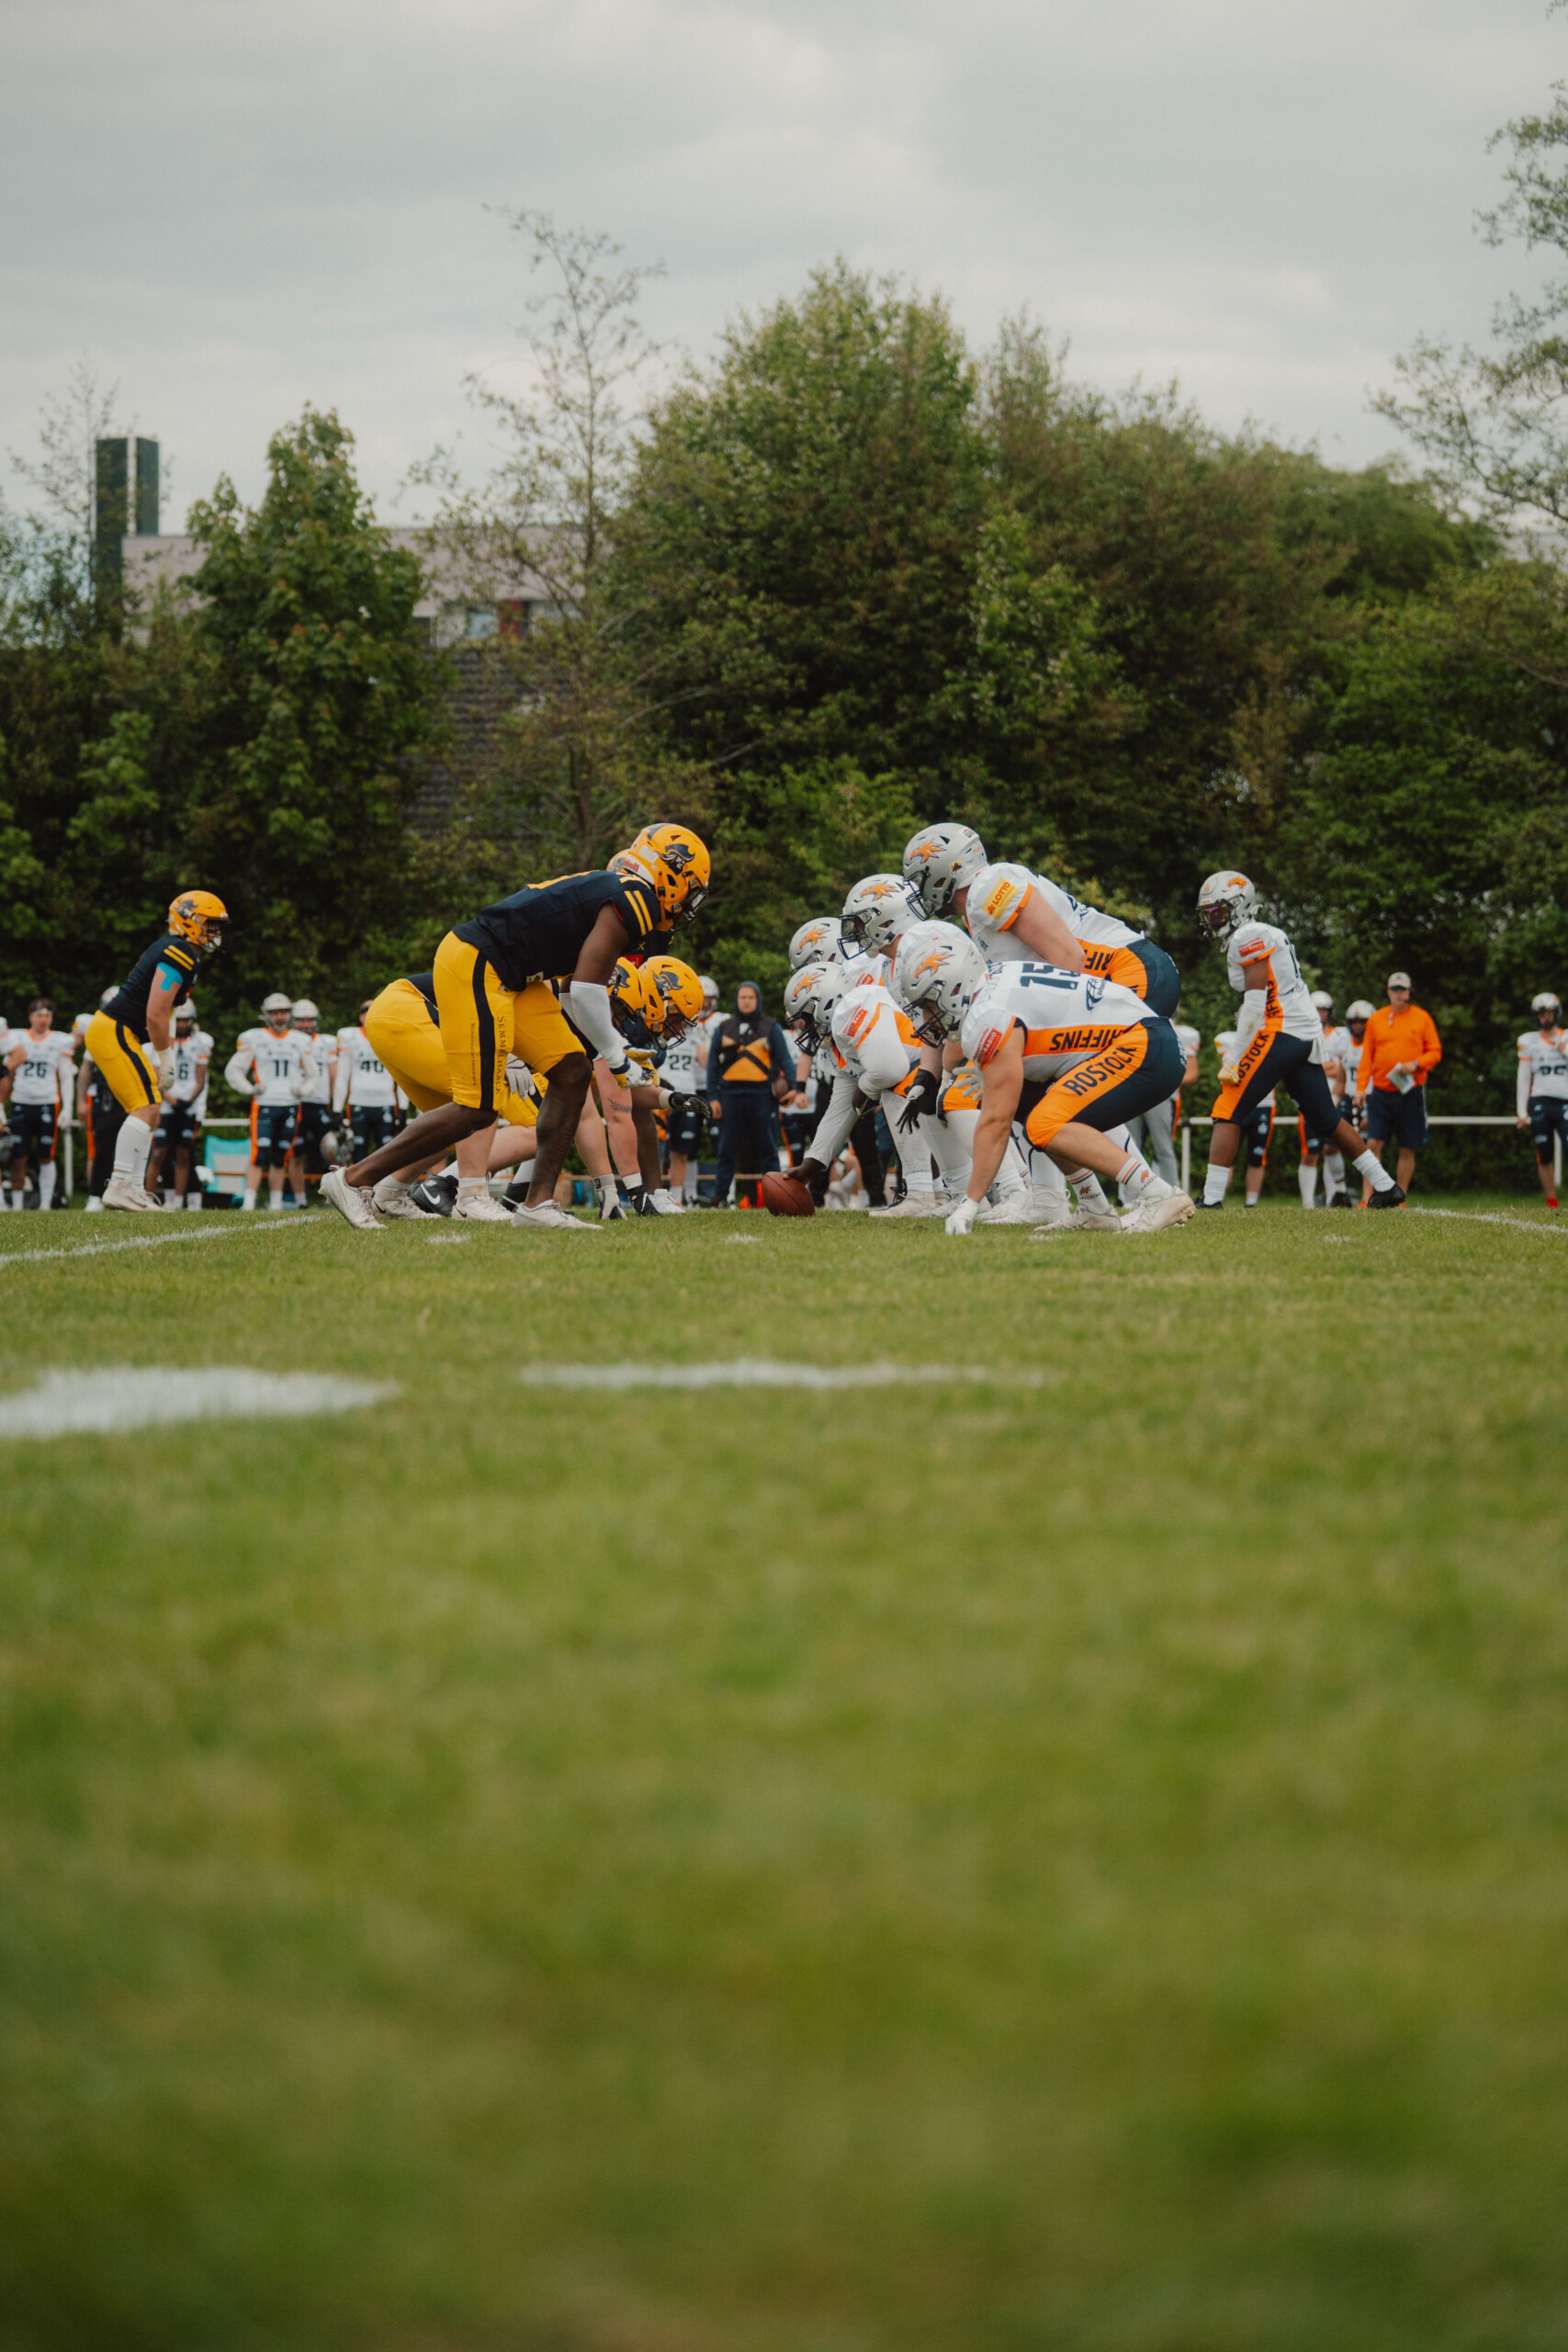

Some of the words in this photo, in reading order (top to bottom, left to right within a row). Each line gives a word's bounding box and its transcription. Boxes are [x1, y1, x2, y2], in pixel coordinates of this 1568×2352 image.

[992, 882, 1011, 905] LOTTO
[983, 1031, 998, 1053] RADIO
[24, 1060, 48, 1080] 26
[272, 1059, 289, 1078] 11
[669, 1054, 692, 1070] 22
[1235, 1031, 1269, 1088] OSTOCK
[1062, 1046, 1137, 1097] ROSTOCK
